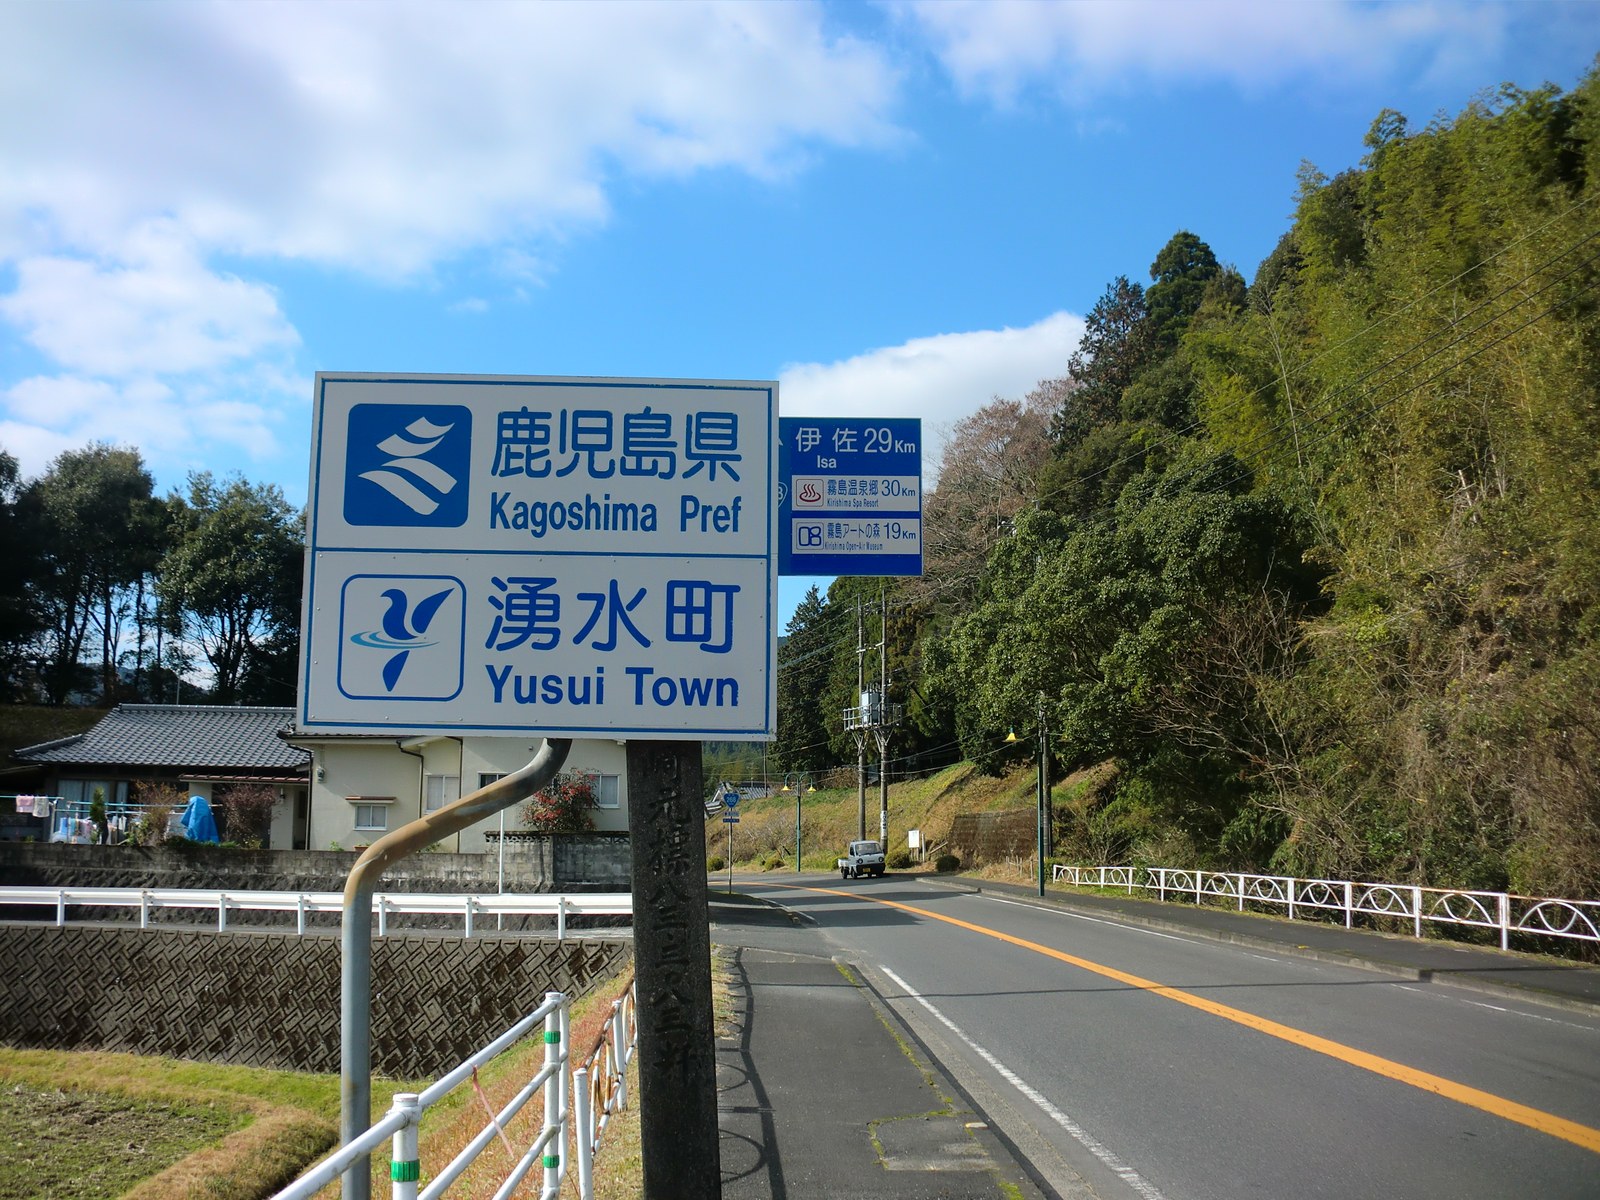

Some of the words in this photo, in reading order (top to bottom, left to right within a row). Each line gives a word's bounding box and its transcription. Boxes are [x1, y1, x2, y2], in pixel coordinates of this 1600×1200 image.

[490, 406, 742, 482] 鹿児島県
[817, 455, 837, 469] Isa
[827, 479, 879, 496] 霧島温泉郷
[490, 492, 658, 539] Kagoshima
[680, 494, 742, 533] Pref
[827, 498, 851, 507] Kirishima
[852, 498, 862, 509] Spa
[863, 498, 879, 508] Resort
[827, 523, 880, 539] 霧島アートの森
[484, 576, 742, 653] 湧水町
[485, 664, 604, 705] Yusui
[626, 667, 738, 706] Town
